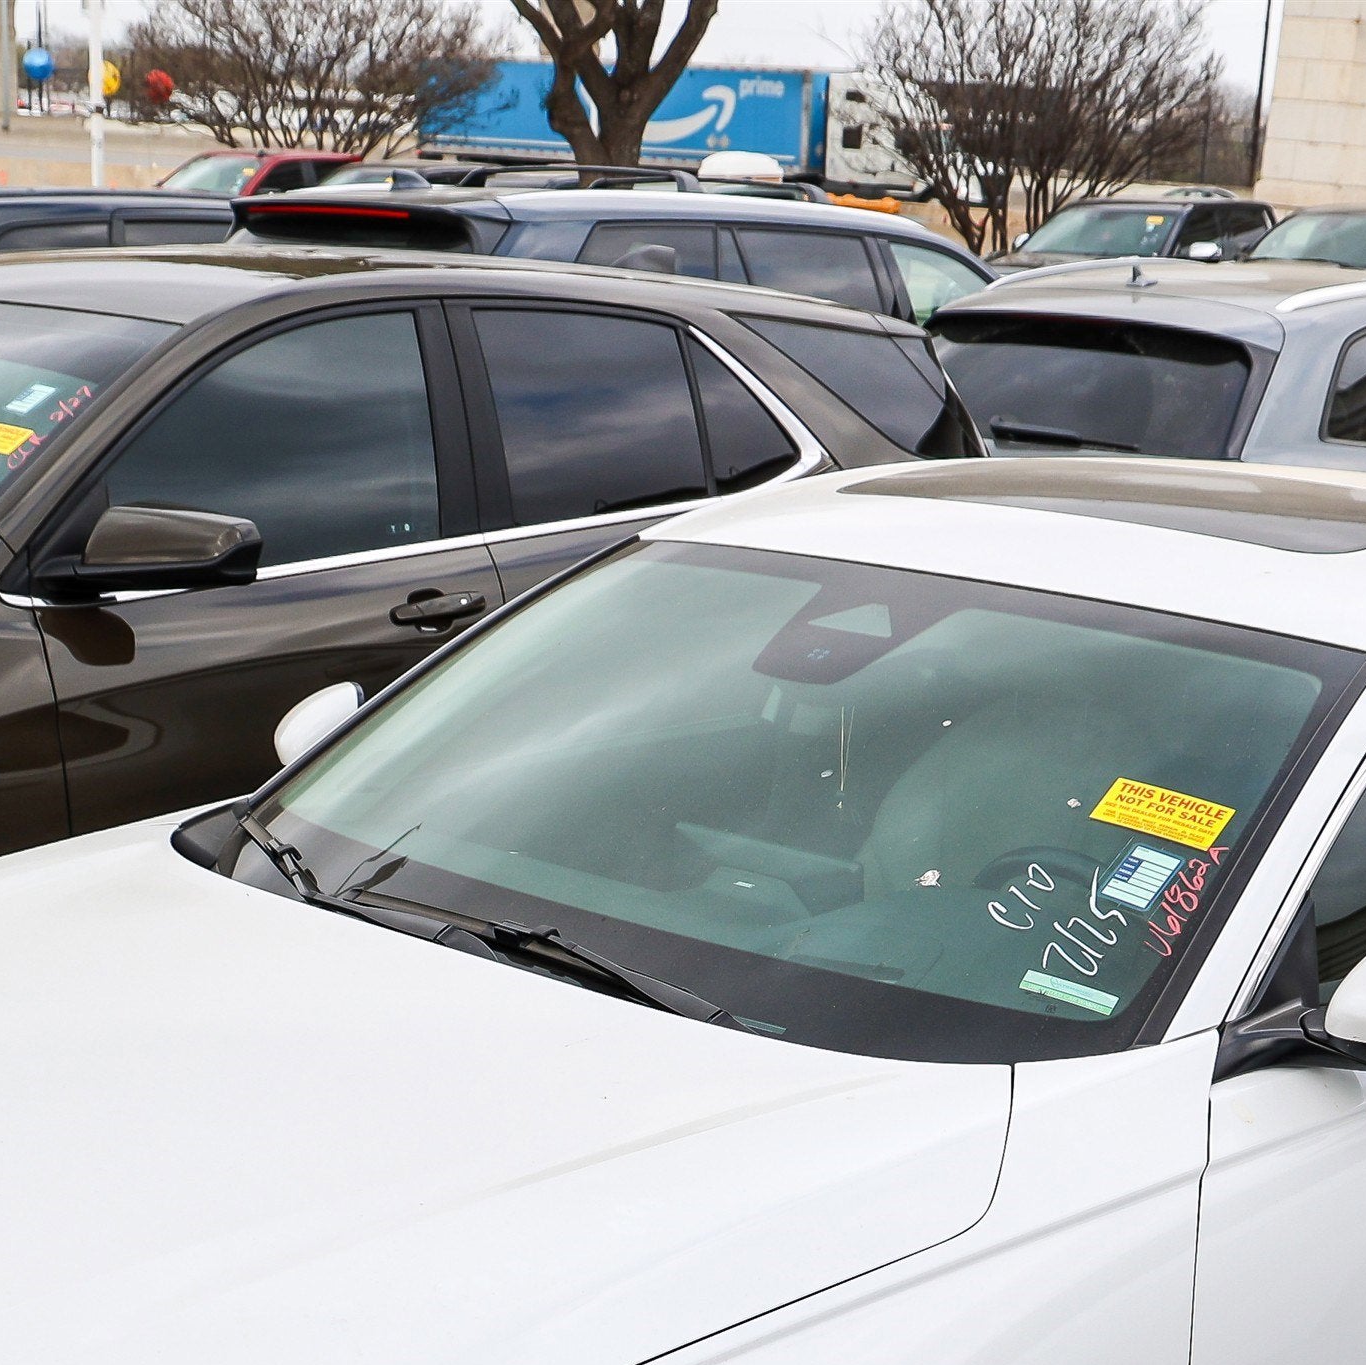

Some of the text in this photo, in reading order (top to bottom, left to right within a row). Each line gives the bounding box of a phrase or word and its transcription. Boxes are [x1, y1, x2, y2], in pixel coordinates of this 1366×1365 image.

[739, 75, 784, 99] prime
[1115, 794, 1145, 807] NOT
[1146, 802, 1176, 816] FOR
[1178, 811, 1217, 828] SALE
[1119, 782, 1228, 820] THIS VEHICLE
